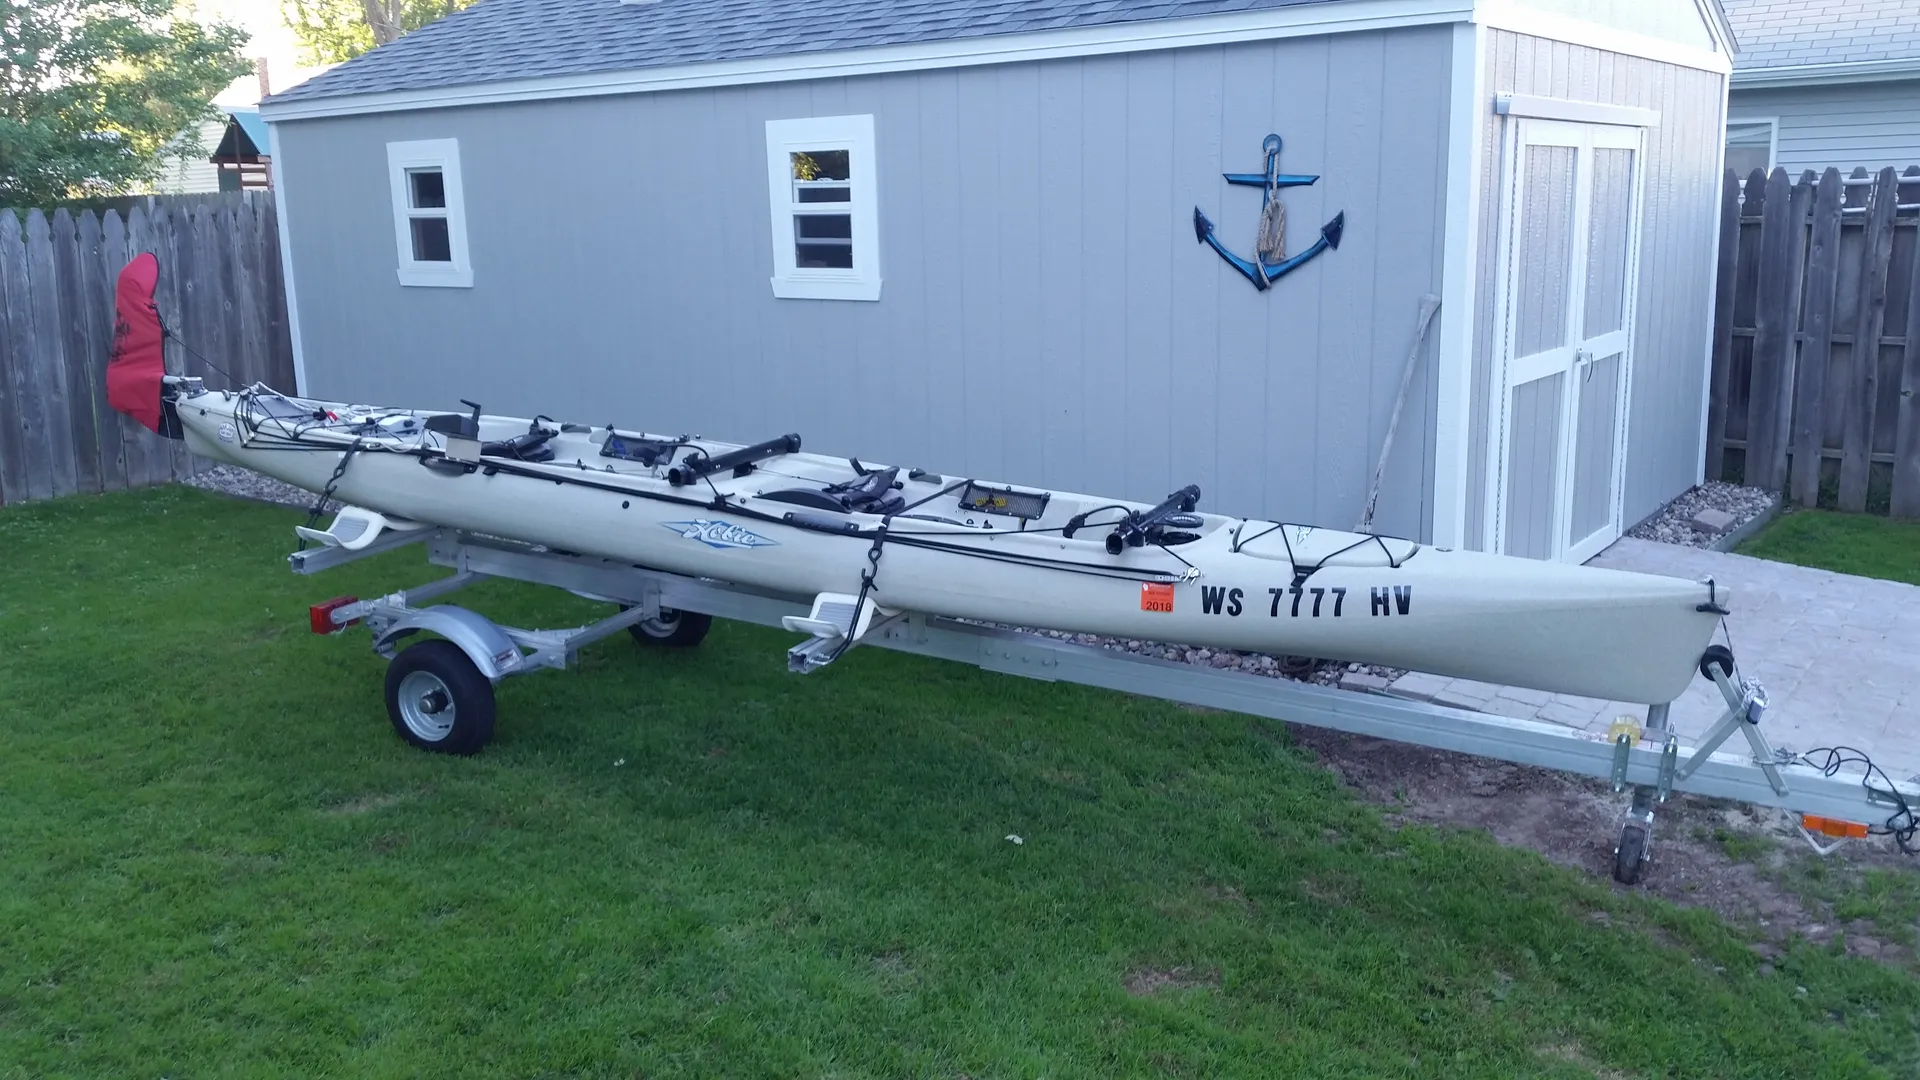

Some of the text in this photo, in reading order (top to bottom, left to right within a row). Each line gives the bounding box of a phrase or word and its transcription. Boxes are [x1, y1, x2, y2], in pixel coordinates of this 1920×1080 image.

[682, 519, 756, 548] Hobie
[1146, 600, 1172, 612] 2018
[1201, 585, 1412, 617] WS 7777 HV
